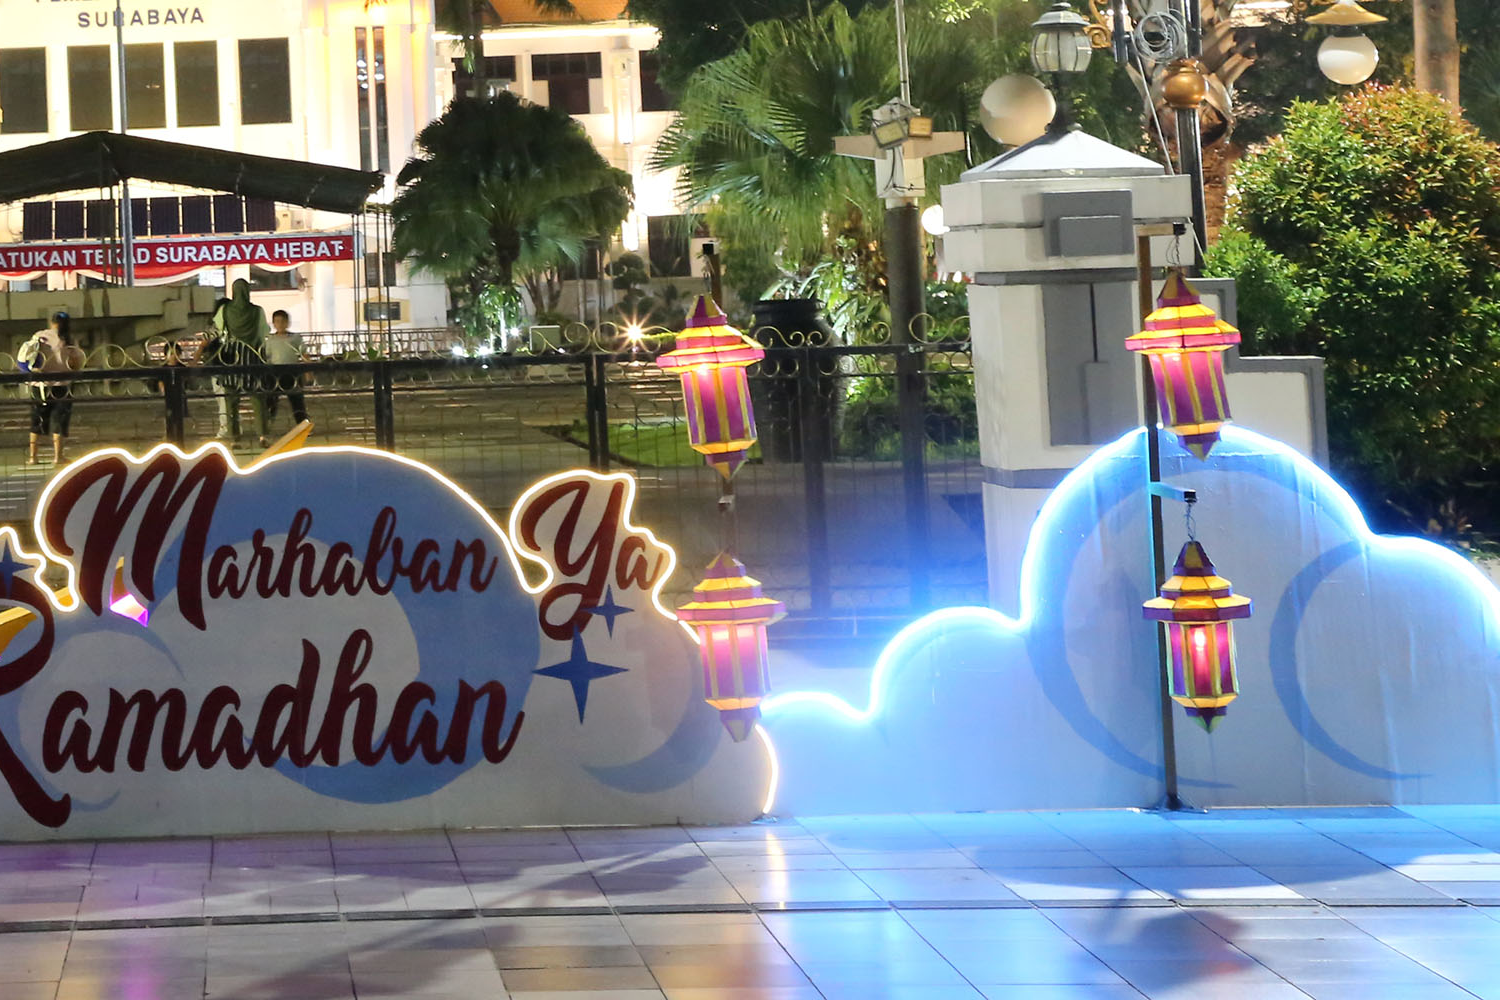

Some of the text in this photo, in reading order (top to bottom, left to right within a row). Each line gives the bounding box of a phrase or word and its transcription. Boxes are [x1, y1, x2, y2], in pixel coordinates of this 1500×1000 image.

[155, 244, 266, 263] SURABAYA
[273, 240, 344, 260] HEBAT
[46, 452, 664, 640] Marhaban Ya
